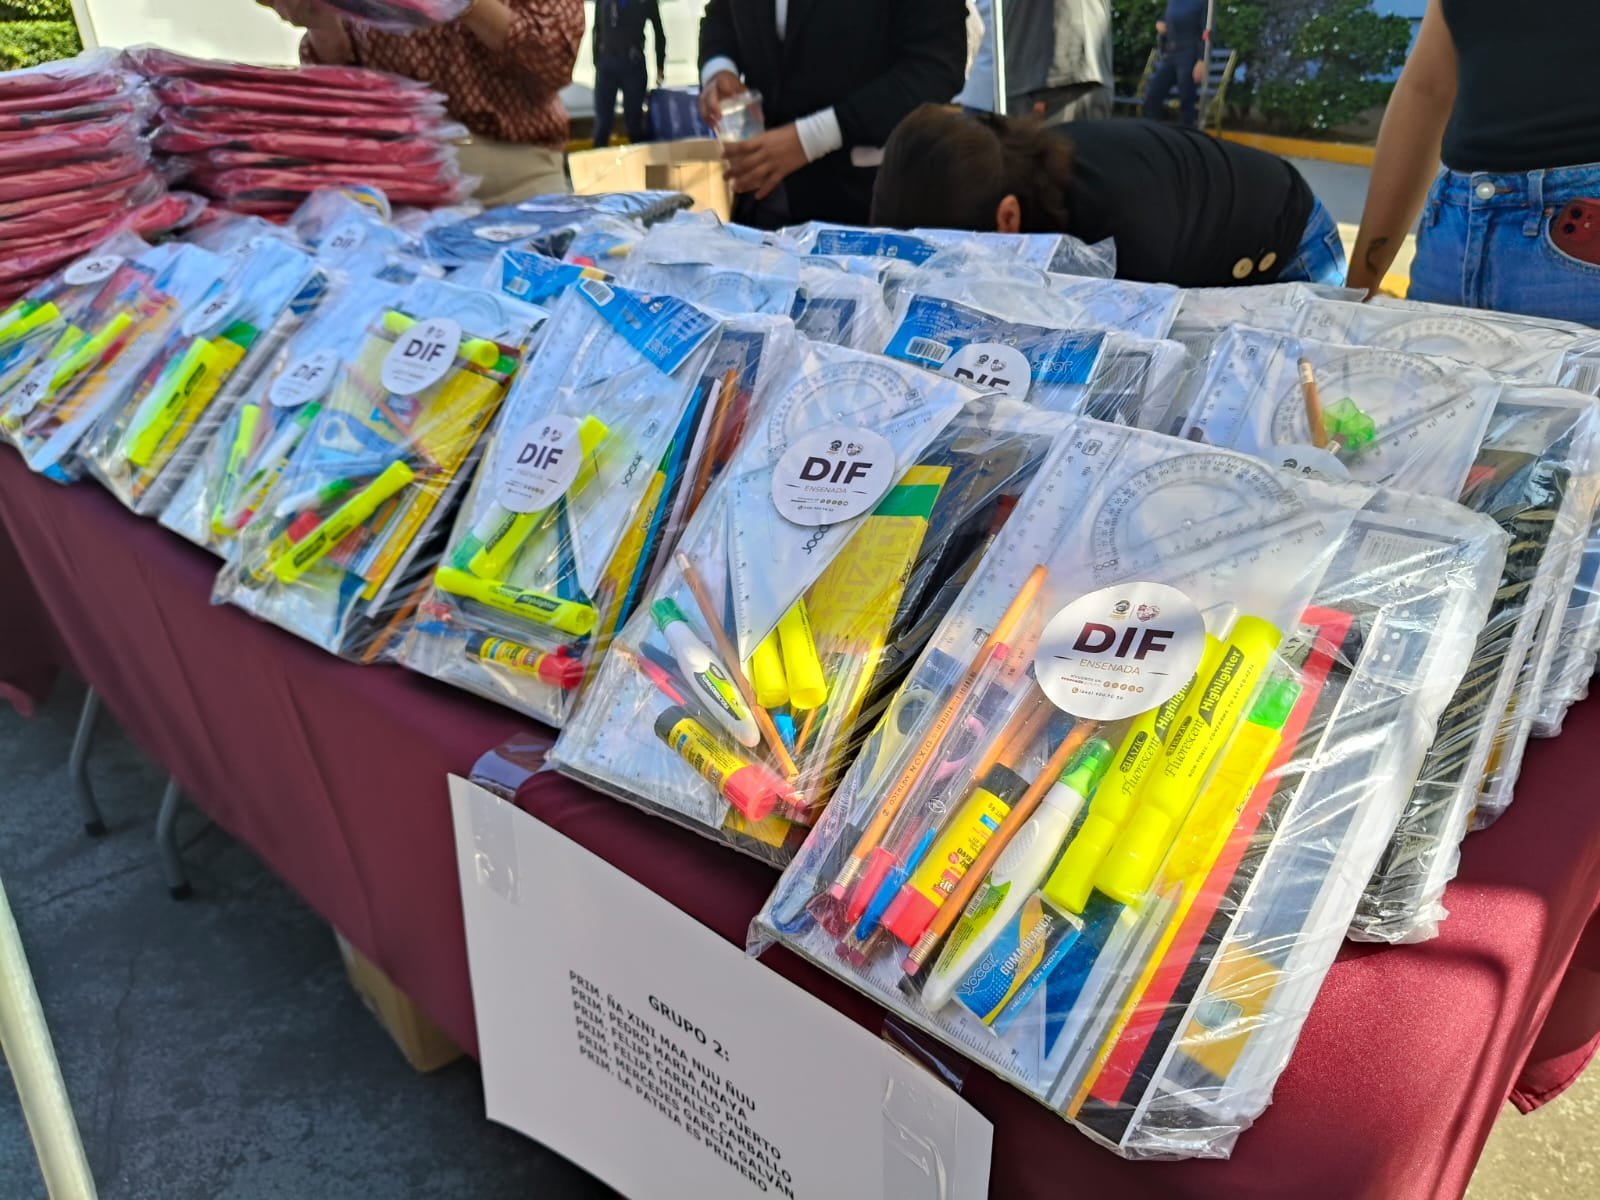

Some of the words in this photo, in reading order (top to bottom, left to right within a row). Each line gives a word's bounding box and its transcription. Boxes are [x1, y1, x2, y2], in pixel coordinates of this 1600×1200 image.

[291, 364, 324, 381] DIF
[403, 339, 447, 362] DIF
[516, 443, 564, 470] DIF
[799, 456, 873, 485] DIF
[804, 485, 847, 494] ENSENADA
[1071, 621, 1175, 660] DIF
[1079, 658, 1142, 676] ENSENADA
[1199, 649, 1242, 713] Highlighter
[909, 740, 934, 774] DIXON
[1122, 736, 1160, 797] Fluorescent
[1165, 719, 1204, 778] Fluorescent
[1000, 947, 1025, 977] GOMA
[1022, 914, 1054, 950] BLANCA
[1032, 971, 1043, 983] EN
[1041, 950, 1060, 971] INDIA
[569, 969, 604, 1001] PRIM.
[606, 993, 624, 1016] ÑA
[627, 1009, 656, 1039] XINI
[660, 1033, 689, 1062] MAA
[692, 1057, 721, 1086] NUU
[726, 1079, 756, 1111] ÑUU
[571, 985, 606, 1016] PRIM.
[609, 1011, 650, 1048] PEDRO
[700, 1079, 747, 1121] ANAYA
[648, 994, 707, 1045] GRUPO
[712, 1039, 730, 1062] 2:
[573, 1000, 608, 1031] PRIM.
[611, 1026, 653, 1064] FELIPE
[656, 1060, 721, 1115] CARRILLO
[725, 1111, 781, 1160] PUERTO
[575, 1014, 610, 1046] PRIM.
[613, 1041, 656, 1080] FELIPA
[660, 1075, 716, 1124] HIRALES
[719, 1120, 792, 1183] CARBALLO
[577, 1030, 612, 1061] PRIM.
[616, 1056, 680, 1111] MERCEDES
[683, 1108, 734, 1153] GARCÍA
[738, 1149, 794, 1200] GALVÁN
[580, 1044, 615, 1076] PRIM.
[618, 1071, 633, 1089] LA
[636, 1084, 682, 1127] PATRIA
[685, 1122, 702, 1141] ES
[705, 1137, 767, 1192] PRIMERO
